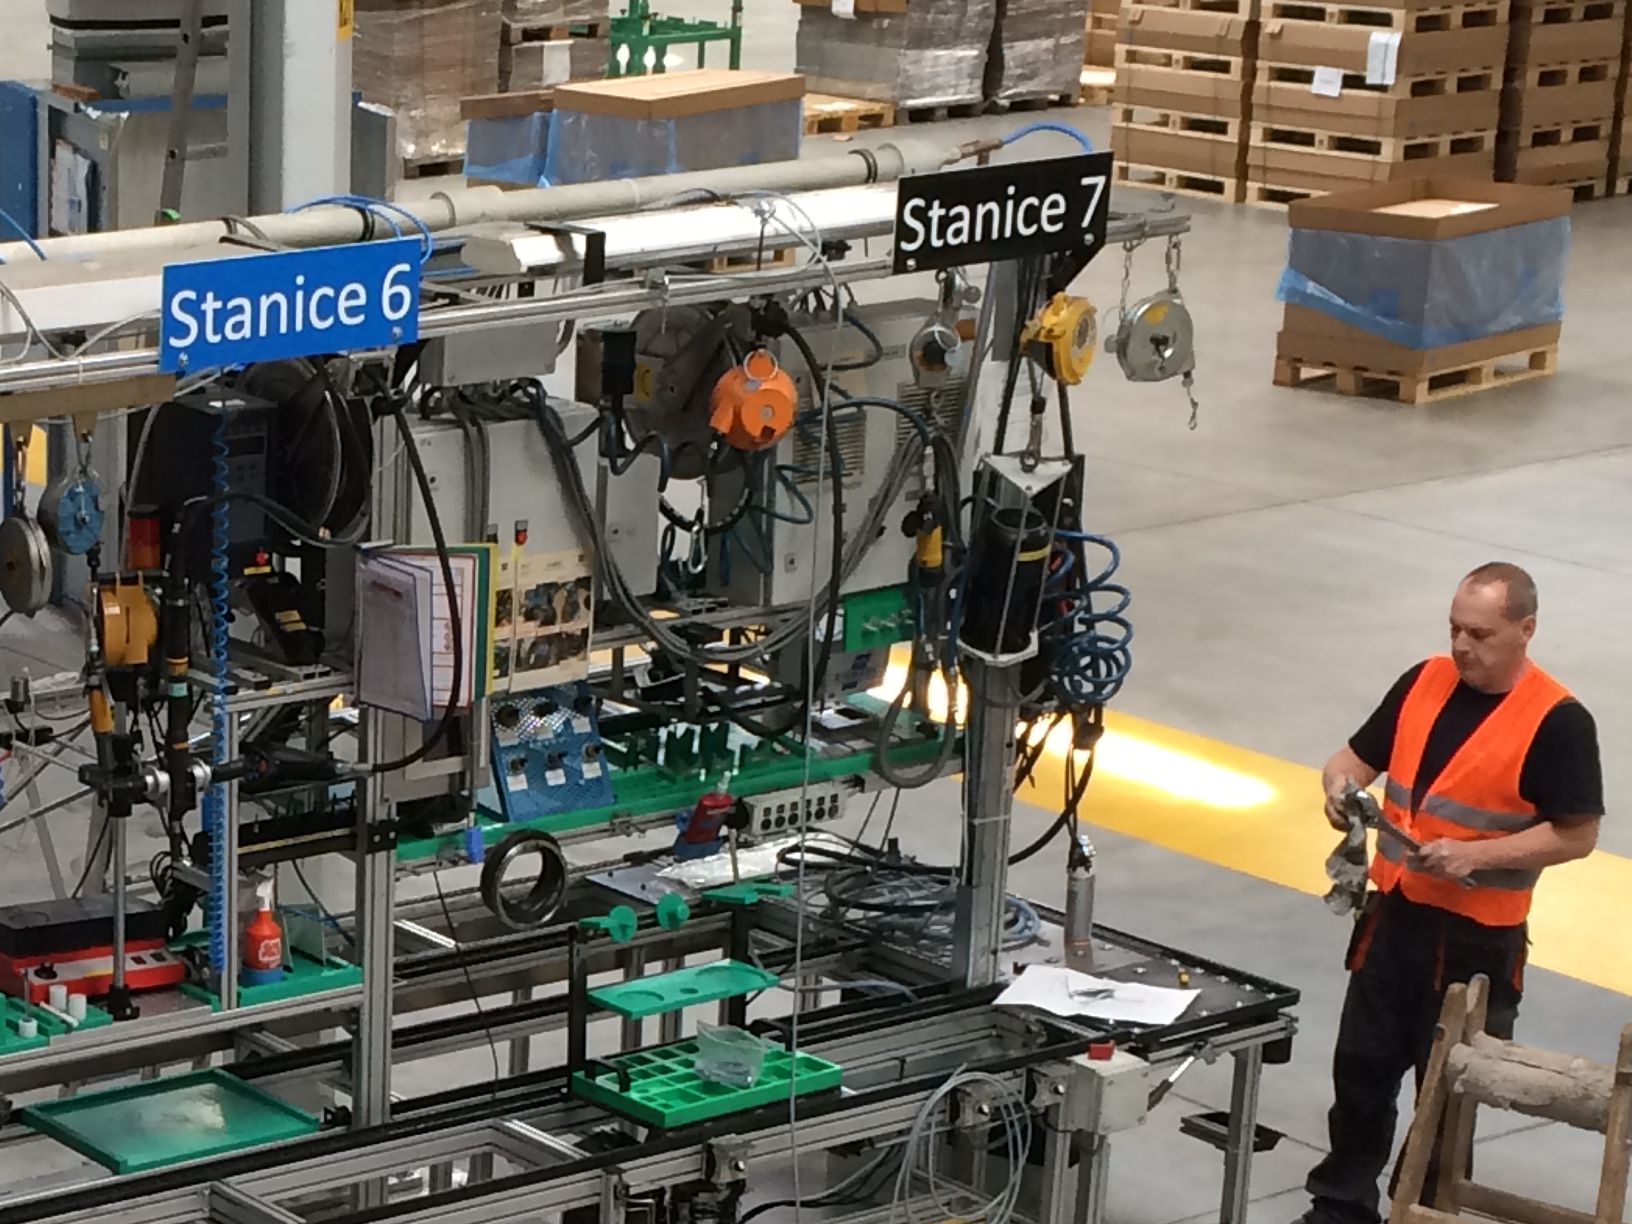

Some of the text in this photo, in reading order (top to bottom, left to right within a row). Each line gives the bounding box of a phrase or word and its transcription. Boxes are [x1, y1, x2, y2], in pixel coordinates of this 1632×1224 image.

[900, 175, 1107, 252] Stanice 7
[168, 262, 412, 348] Stanice 6
